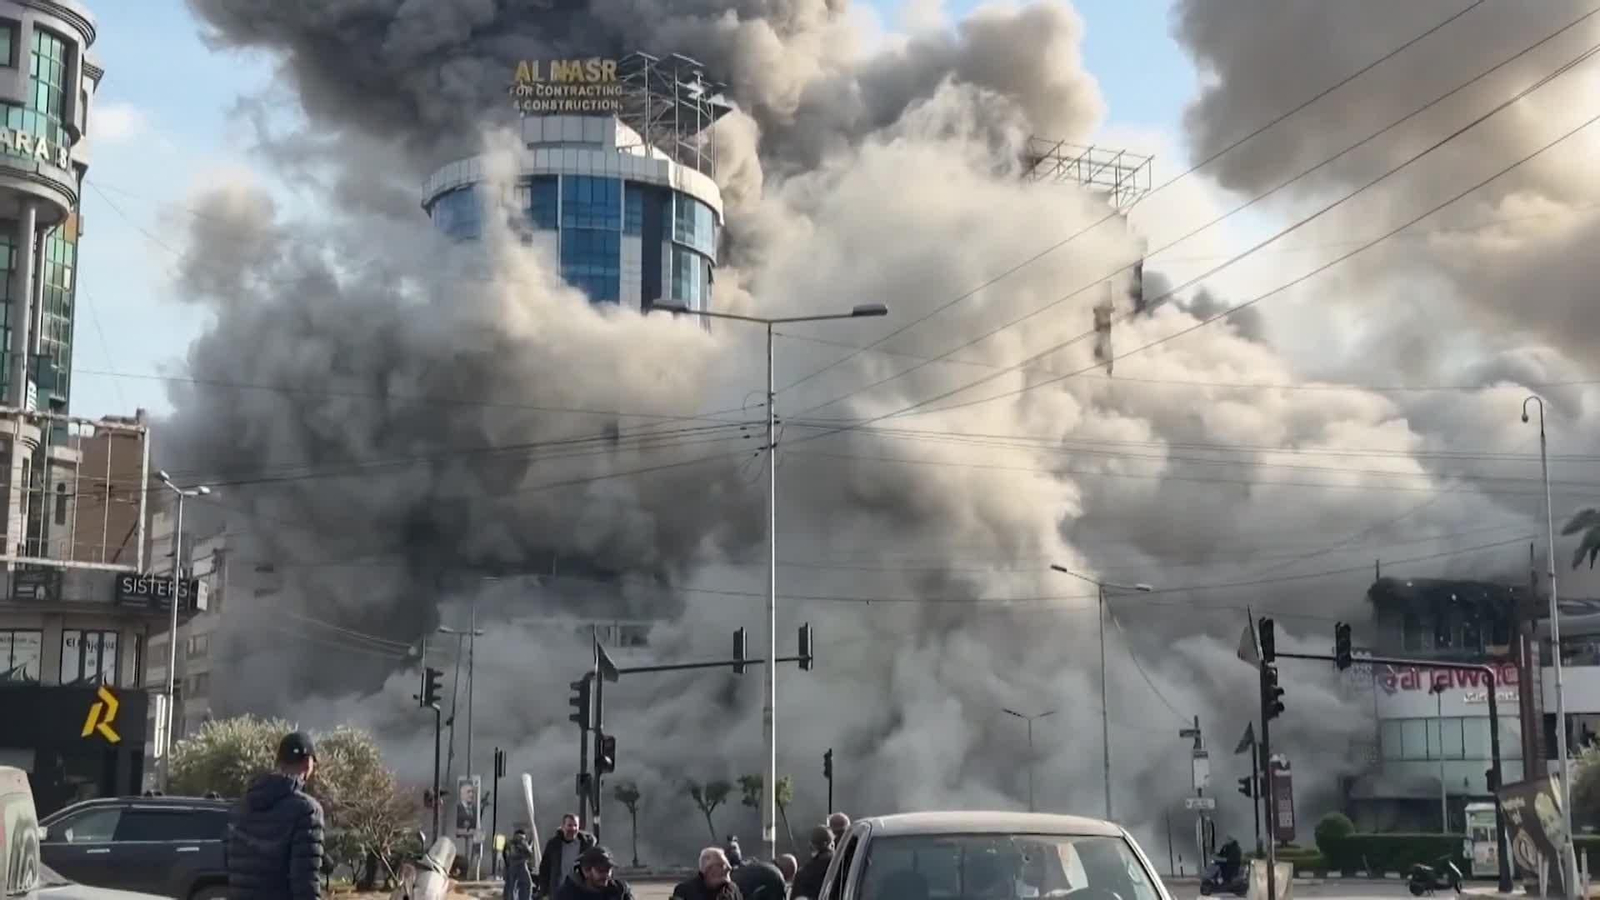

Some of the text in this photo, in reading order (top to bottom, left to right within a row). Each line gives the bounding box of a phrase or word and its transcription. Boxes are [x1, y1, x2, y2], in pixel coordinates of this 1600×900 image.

[514, 59, 617, 82] AL NASR
[510, 85, 622, 96] FOR CONTRACTING
